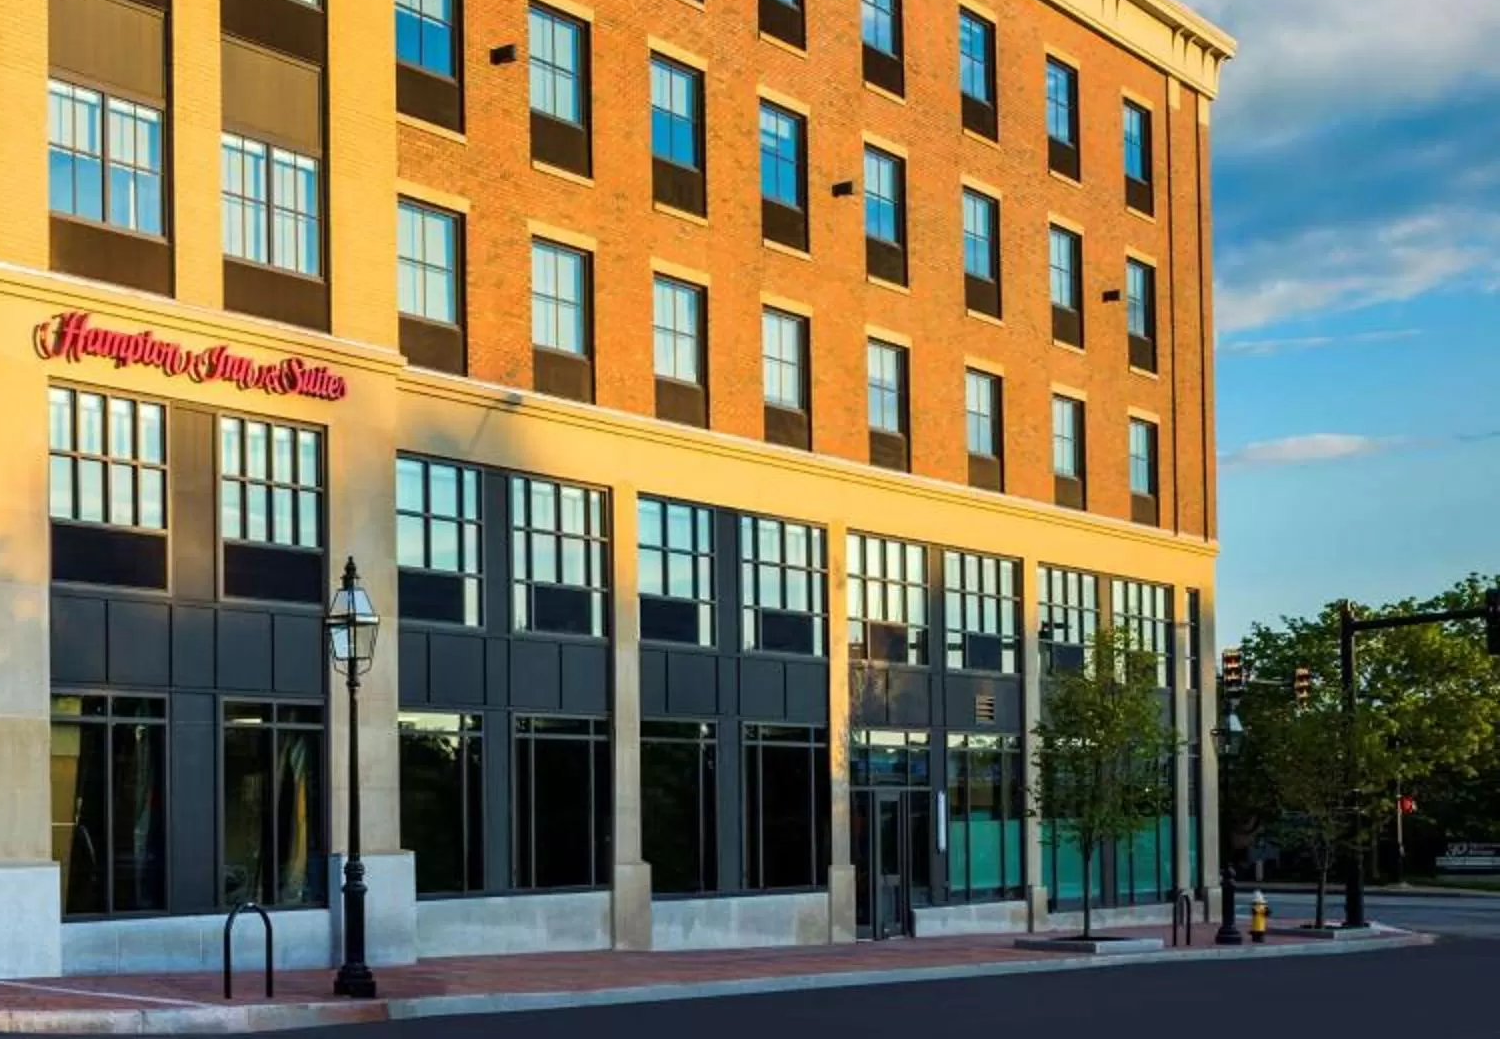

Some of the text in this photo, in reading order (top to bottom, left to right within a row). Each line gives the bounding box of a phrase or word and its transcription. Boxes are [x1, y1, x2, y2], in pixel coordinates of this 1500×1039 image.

[33, 311, 192, 377] Hampton
[188, 345, 263, 391] Inn
[278, 357, 346, 401] Suites
